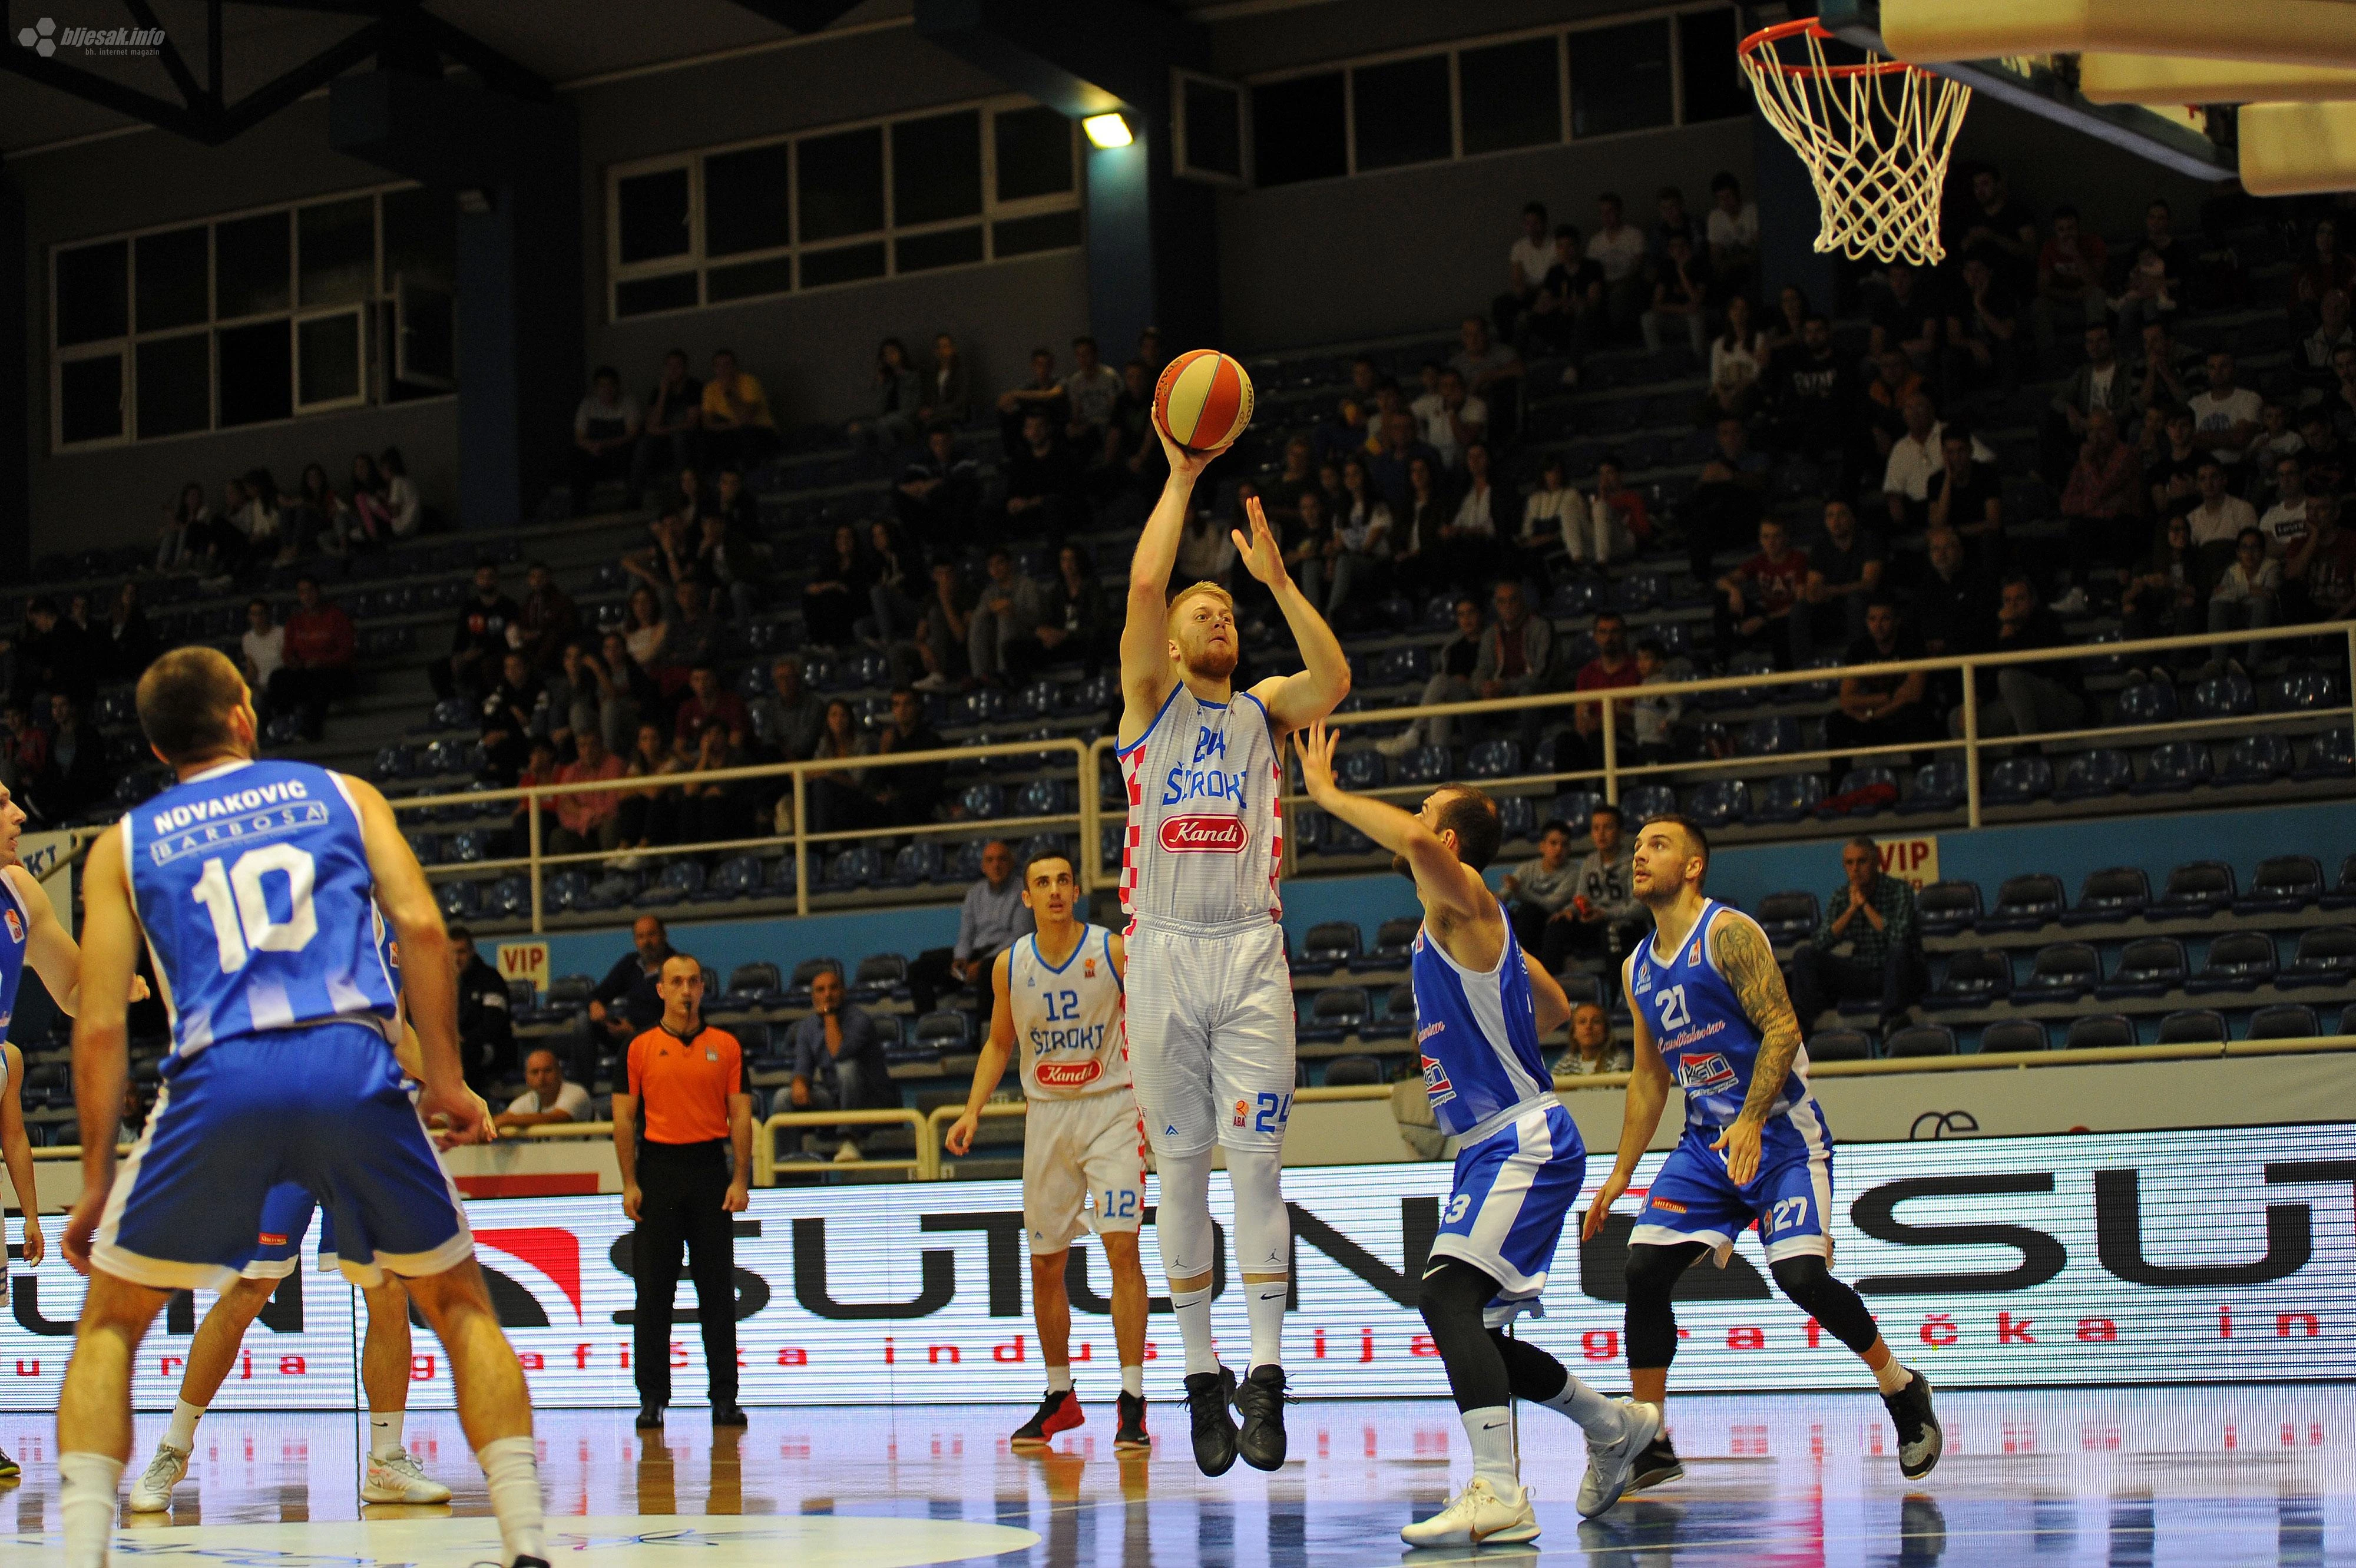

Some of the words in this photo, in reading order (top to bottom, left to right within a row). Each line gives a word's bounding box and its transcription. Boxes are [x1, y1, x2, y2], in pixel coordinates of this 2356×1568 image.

[157, 808, 324, 859] BARBOSA
[1876, 841, 1929, 872] VIP
[191, 843, 318, 974] 10
[504, 947, 543, 973] VIP
[1043, 990, 1080, 1021] 12
[1233, 1116, 1246, 1128] ABA
[1104, 1190, 1136, 1218] 12
[1773, 1196, 1808, 1232] 27
